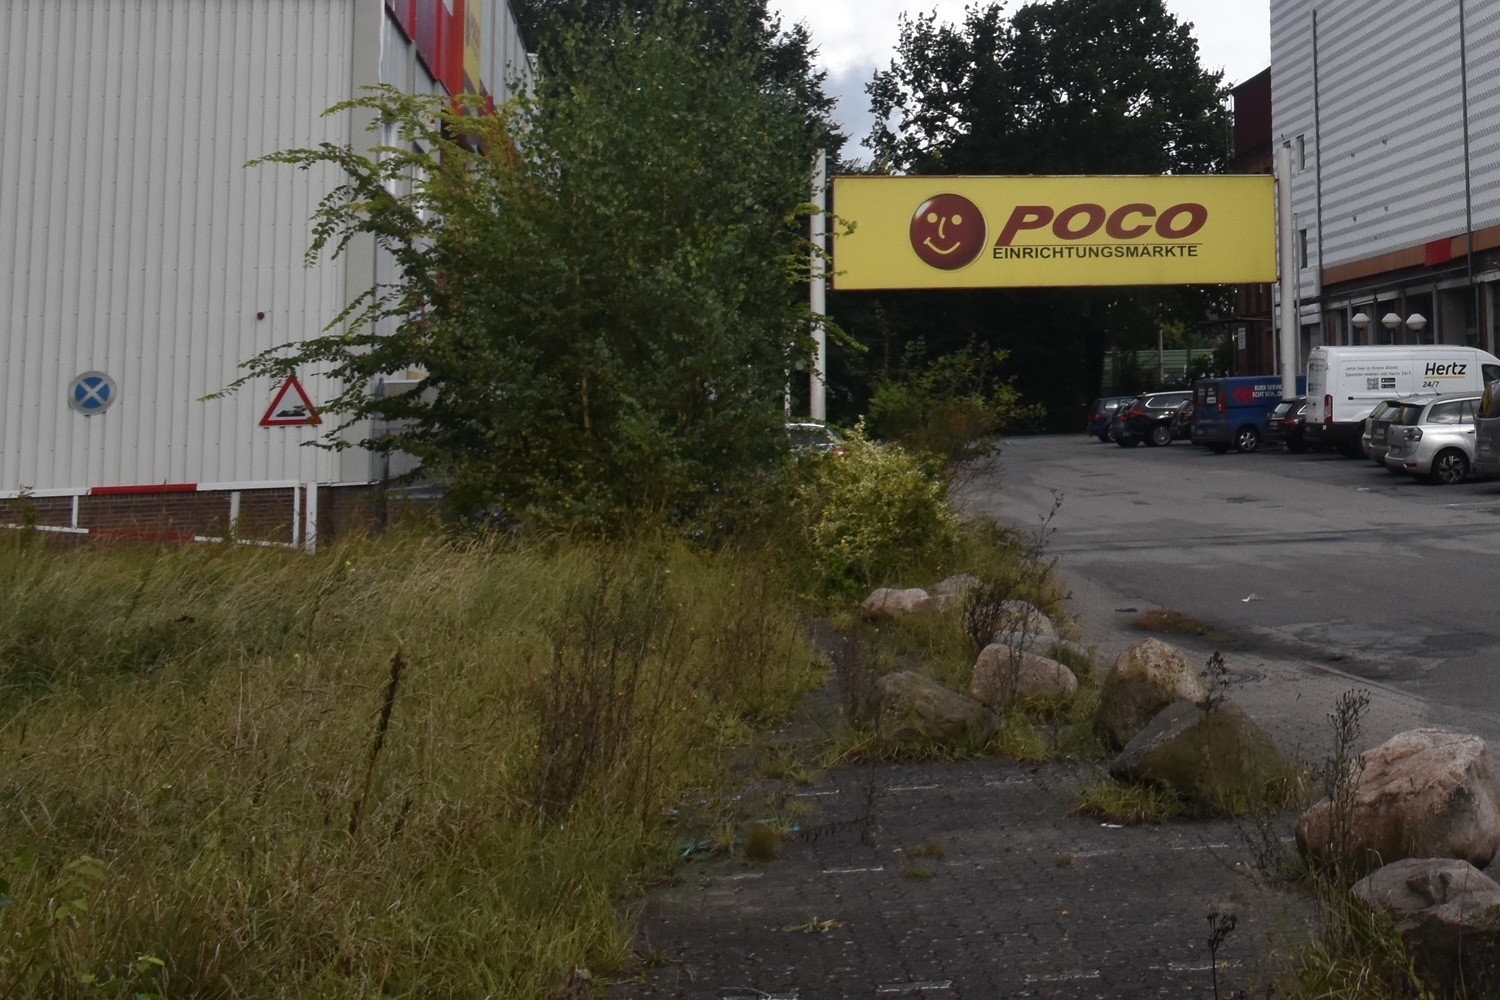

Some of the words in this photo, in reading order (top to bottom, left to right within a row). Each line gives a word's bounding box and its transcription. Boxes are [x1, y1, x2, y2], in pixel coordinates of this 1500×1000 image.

[994, 203, 1208, 247] POCO
[993, 243, 1198, 259] EINRICHTUNGSMÄRKTE
[1424, 362, 1467, 375] Hertz
